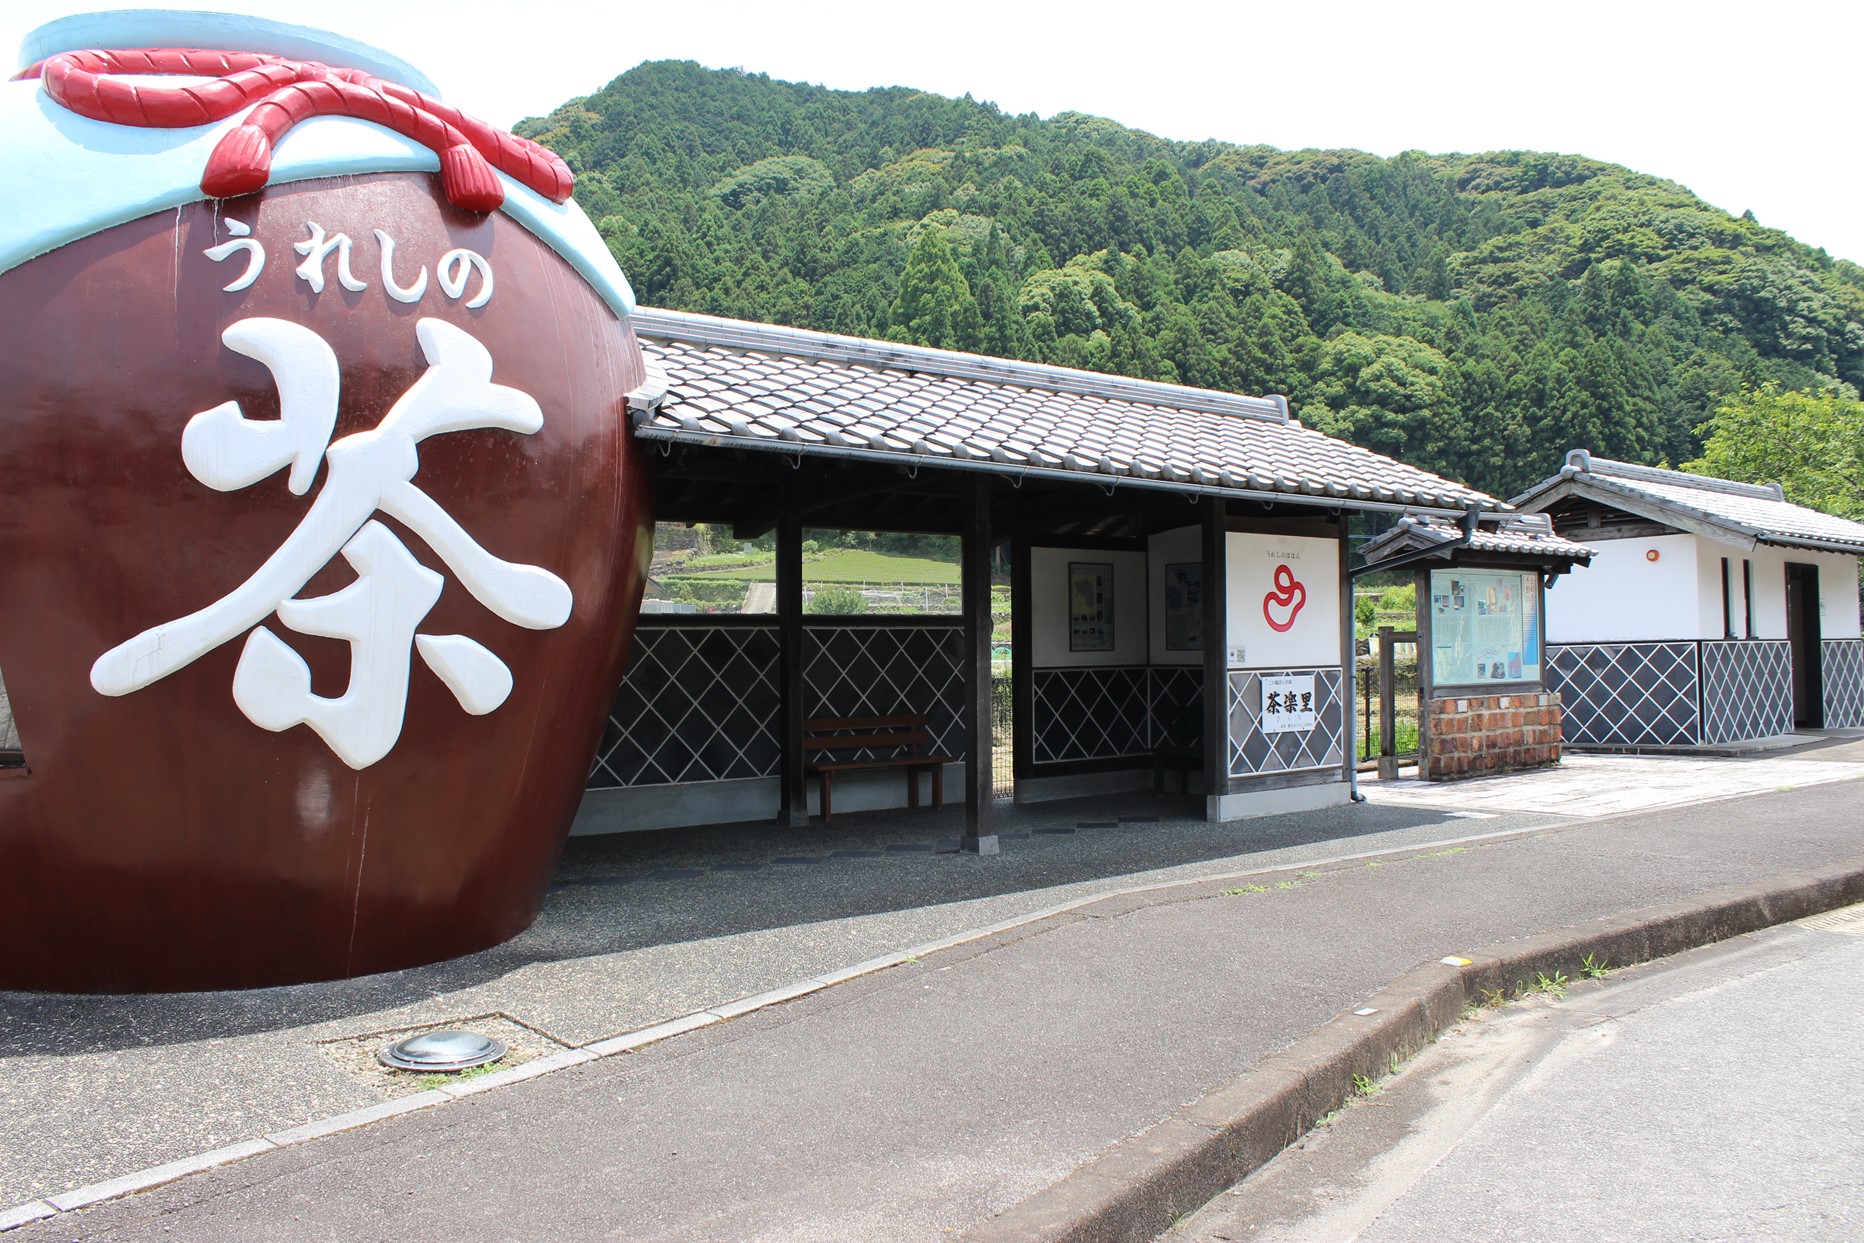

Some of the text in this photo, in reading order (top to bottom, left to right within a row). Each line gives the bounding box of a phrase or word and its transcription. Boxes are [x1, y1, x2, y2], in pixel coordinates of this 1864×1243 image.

[203, 217, 494, 309] うれしの
[90, 317, 573, 770] 茶
[1266, 691, 1313, 715] 茶楽里
